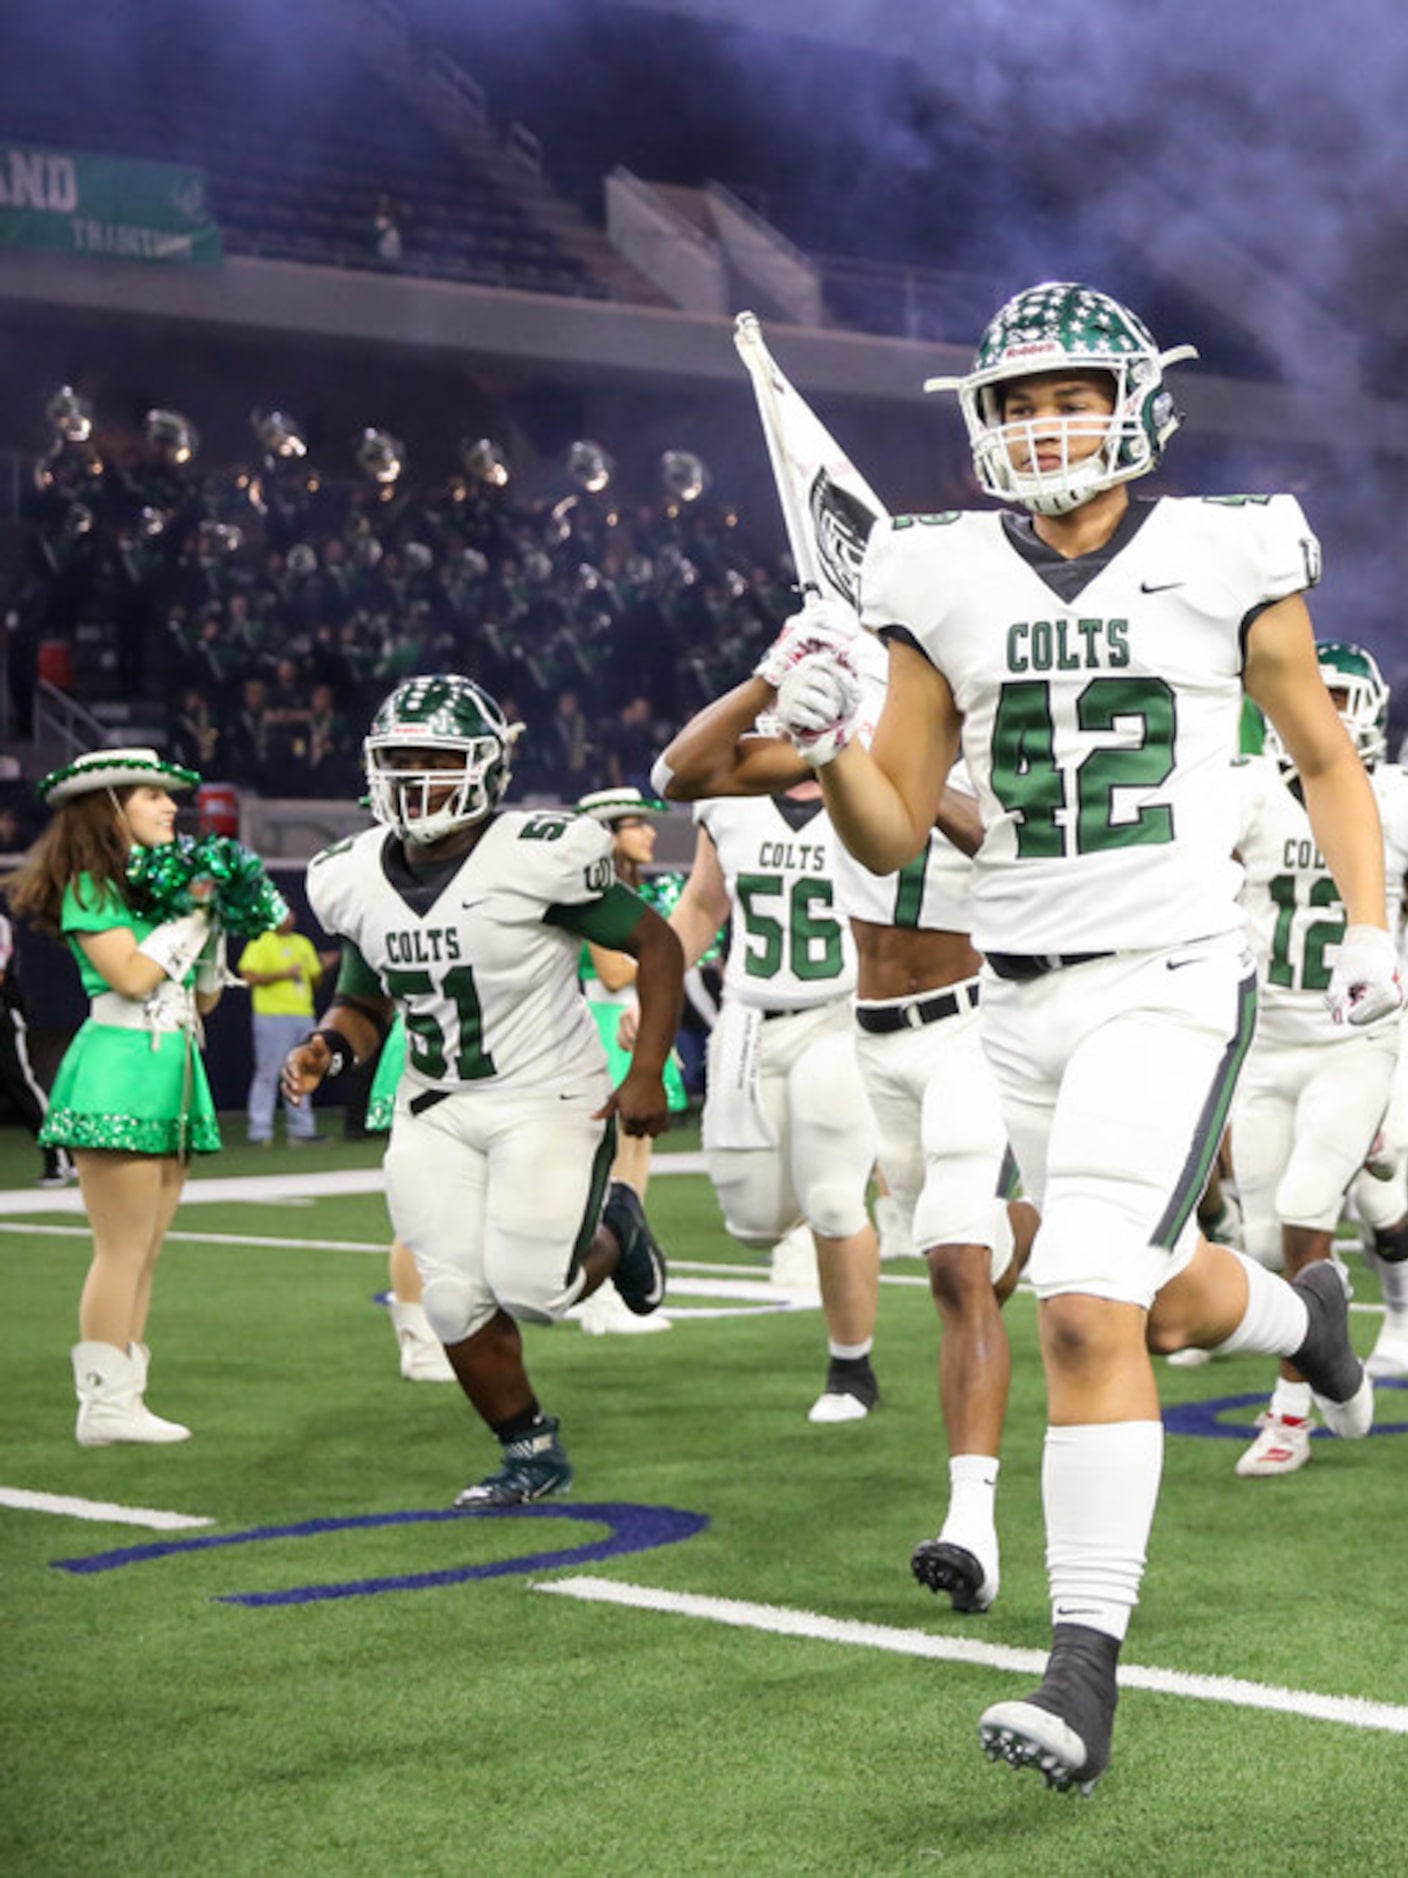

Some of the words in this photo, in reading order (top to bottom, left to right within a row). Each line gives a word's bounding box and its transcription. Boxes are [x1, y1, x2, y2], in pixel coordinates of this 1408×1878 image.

[1007, 619, 1131, 672] COLTS
[990, 676, 1178, 859] 42
[759, 841, 826, 871] COLTS
[1284, 838, 1327, 869] COL
[385, 927, 462, 963] COLTS
[736, 873, 845, 981] 56
[1268, 875, 1348, 990] 12
[381, 965, 498, 1080] 51
